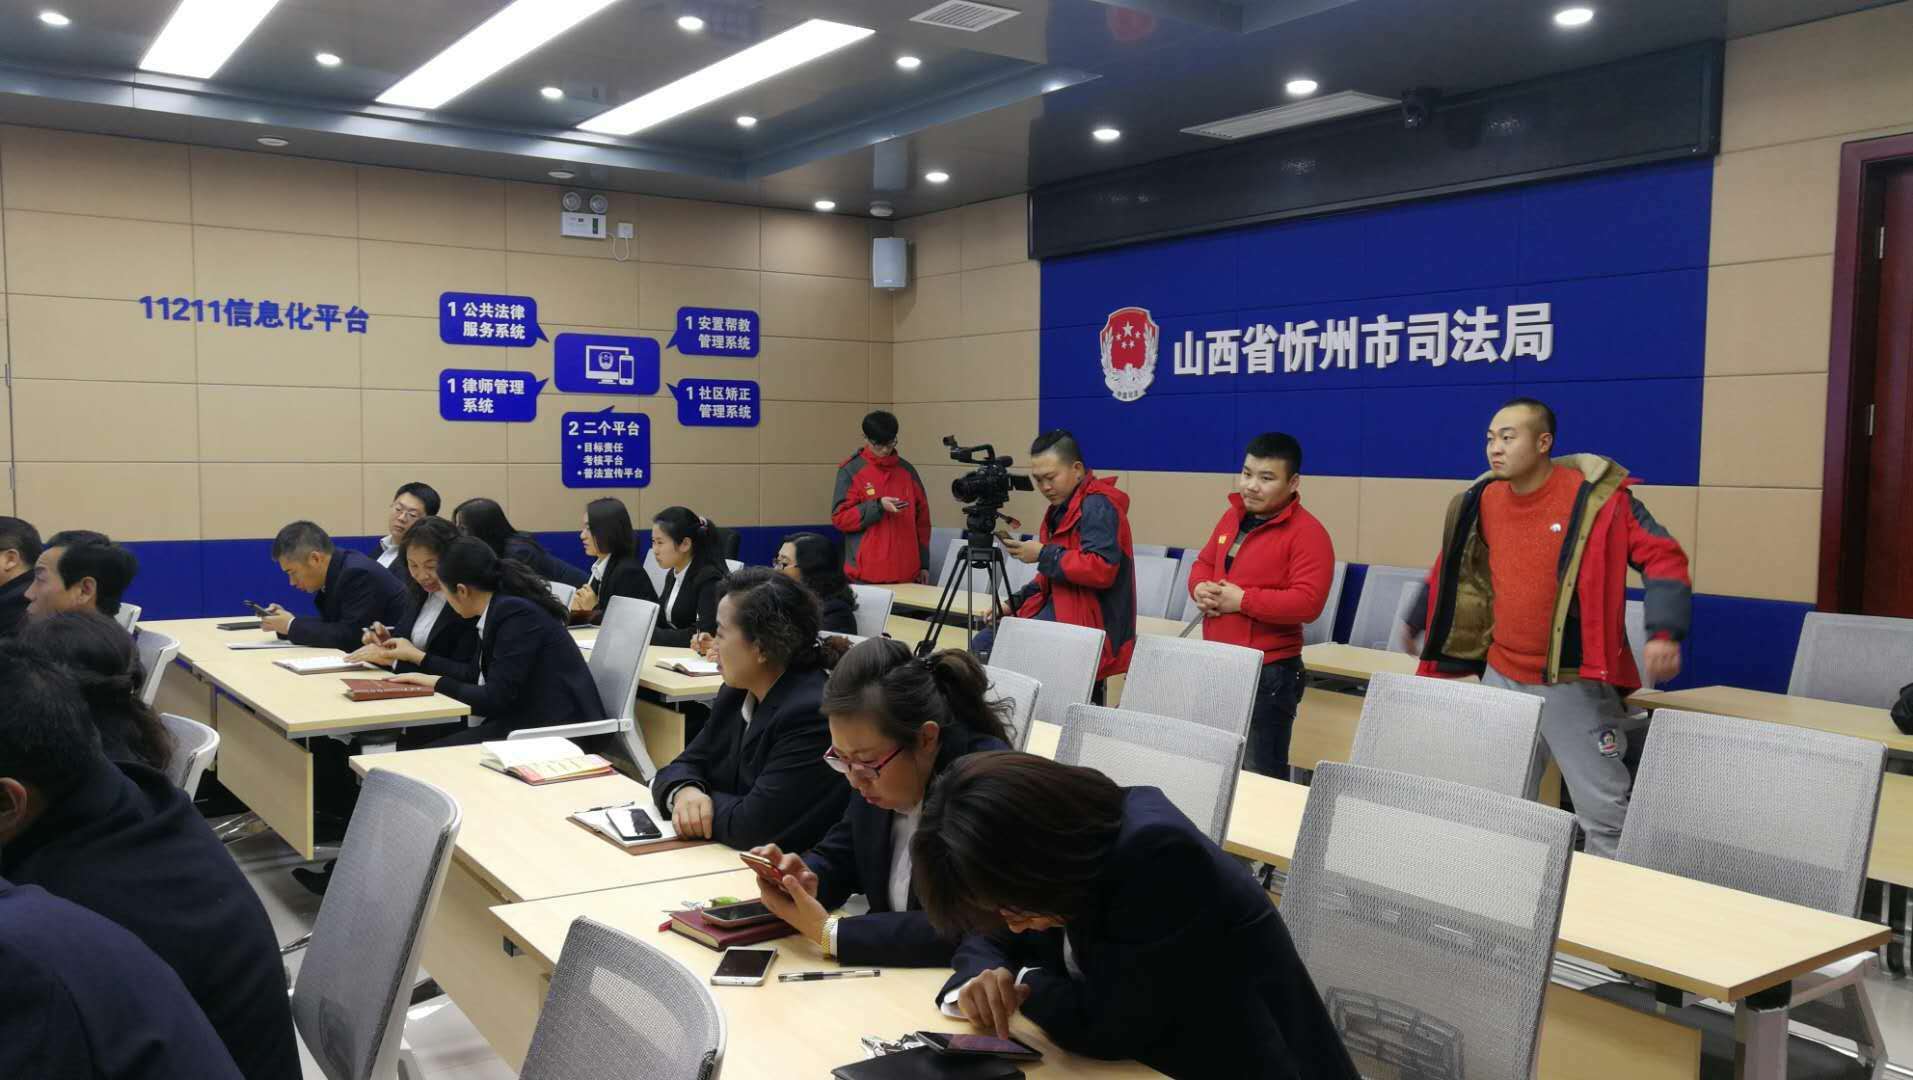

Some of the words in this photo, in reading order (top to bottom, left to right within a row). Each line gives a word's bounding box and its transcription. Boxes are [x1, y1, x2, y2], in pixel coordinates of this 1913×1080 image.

[138, 295, 370, 334] 11211信息化平台
[447, 301, 457, 318] 1
[462, 302, 526, 320] 公共法律
[462, 321, 526, 340] 服务系统
[685, 315, 693, 330] 1
[698, 315, 751, 332] 安置帮教
[698, 333, 751, 350] 管理系统
[1173, 302, 1554, 376] 山西省忻州市司法局
[447, 378, 456, 394] 1
[462, 378, 525, 395] 律师管理
[685, 386, 694, 401] 1
[698, 385, 752, 402] 社区矫正
[462, 397, 495, 414] 系统
[698, 403, 752, 420] 管理系统
[568, 420, 580, 436] 2
[583, 420, 640, 437] 二个平台
[583, 442, 624, 453] 目标责任
[583, 455, 624, 466] 考核平台
[583, 467, 643, 479] 普法宣传平台
